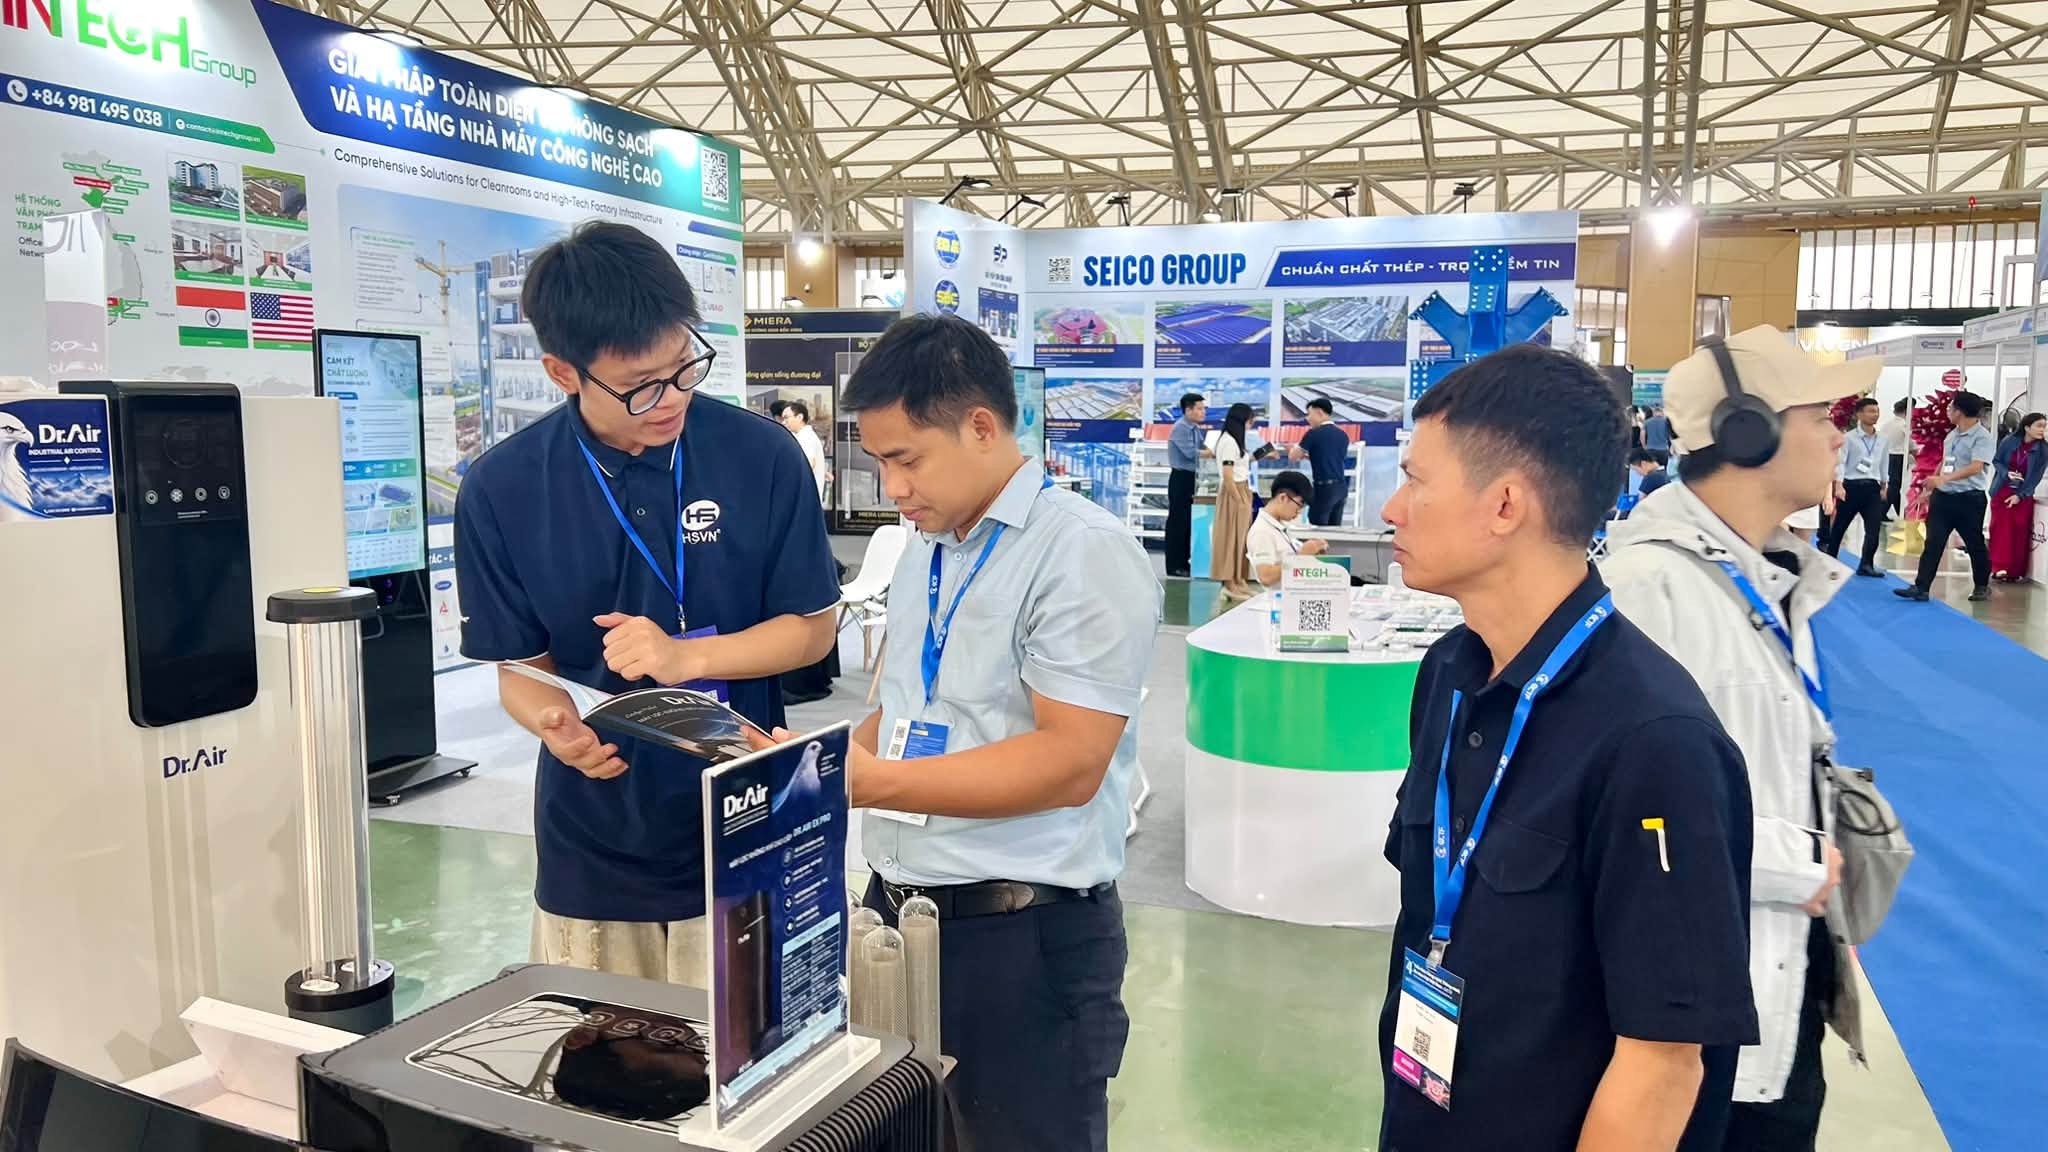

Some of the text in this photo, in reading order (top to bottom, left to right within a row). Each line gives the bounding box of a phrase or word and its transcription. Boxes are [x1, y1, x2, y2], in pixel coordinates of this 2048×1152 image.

[191, 48, 257, 88] Group
[32, 88, 163, 127] +84 981 495 038
[438, 78, 491, 113] TOÀN
[617, 129, 655, 158] SẠCH
[330, 83, 663, 188] VÀ HẠ TẦNG NHÀ MÁY CÔNG NGHỆ CAO
[334, 148, 663, 225] Comprehensive Solutions for Cleanrooms and High-Tech Factory Infrastructure
[18, 236, 43, 247] Office
[1083, 252, 1246, 287] SEICO GROUP
[1281, 260, 1334, 276] CHUẨN
[1339, 257, 1380, 275] CHẤT
[1384, 257, 1424, 274] THÉP
[1533, 259, 1560, 269] TIN
[753, 316, 793, 326] MIERA
[38, 423, 101, 444] Dr.Air
[28, 448, 64, 456] INDUSTRIAL
[74, 447, 103, 455] CONTROL
[163, 745, 227, 778] Dr.Air
[723, 784, 769, 818] Dr.Air
